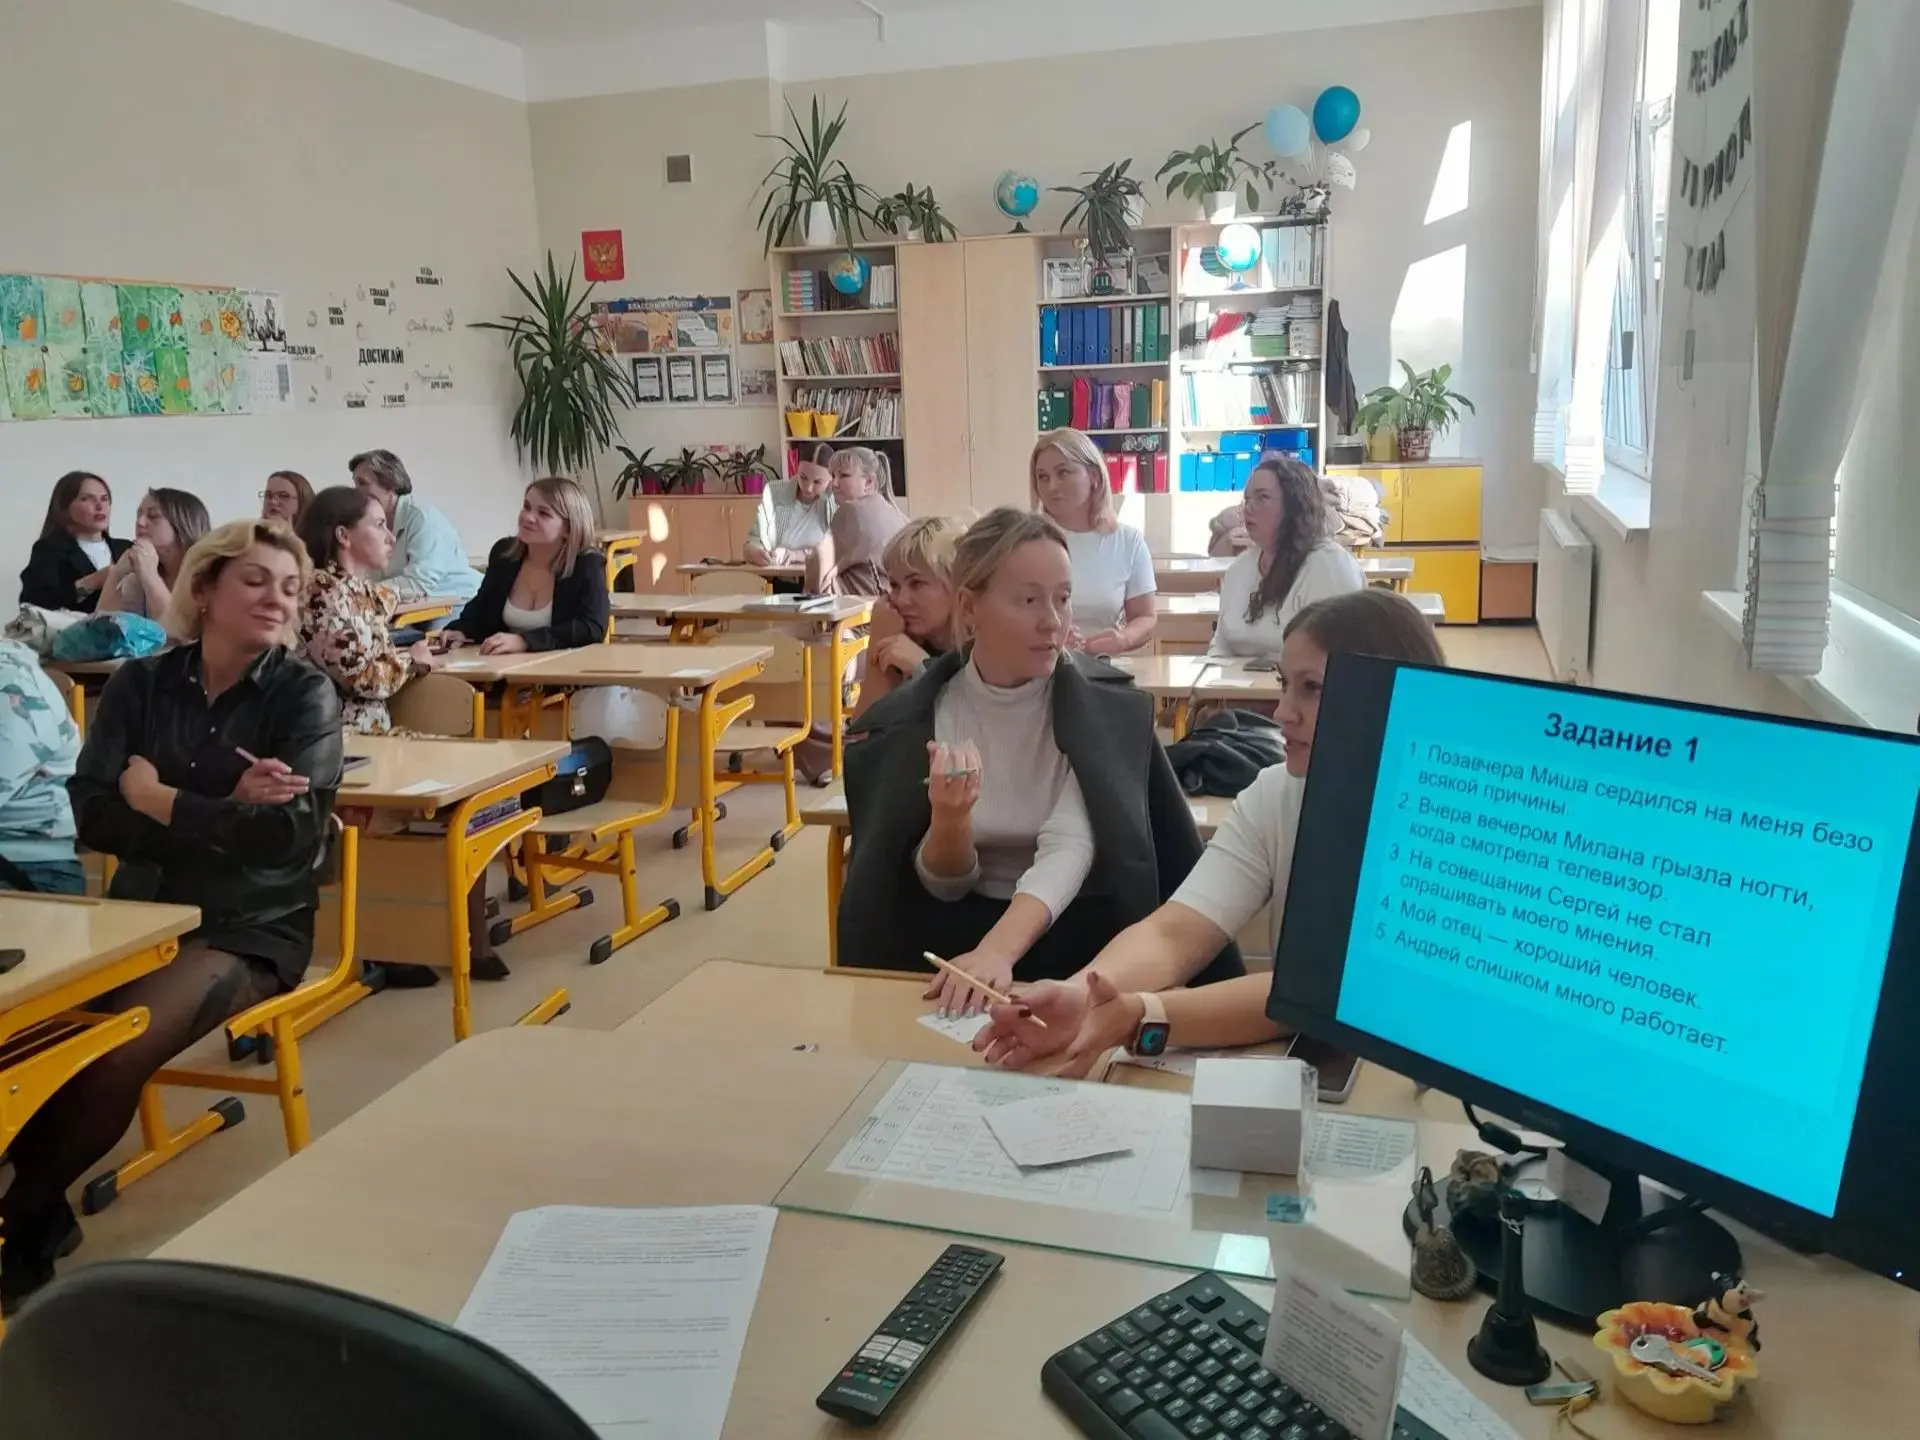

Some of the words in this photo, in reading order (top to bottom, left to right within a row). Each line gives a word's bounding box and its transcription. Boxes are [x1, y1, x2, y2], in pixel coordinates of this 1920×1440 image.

[359, 347, 404, 366] ДОСТИГАЙ!
[1418, 769, 1478, 795] всякой
[1543, 712, 1672, 759] Задание
[1685, 736, 1699, 763] 1
[1427, 744, 1524, 781] Позавчера
[1530, 765, 1589, 794] Миша
[1594, 780, 1698, 817] сердился
[1704, 803, 1733, 825] на
[1740, 811, 1804, 839] меня
[1812, 821, 1874, 854] безо
[1408, 822, 1456, 846] когда
[1460, 835, 1550, 871] смотрела
[1556, 858, 1668, 903] телевизор.
[1408, 848, 1433, 871] На
[1437, 860, 1542, 901] совещании
[1547, 886, 1621, 922] Сергей
[1625, 911, 1653, 932] не
[1658, 920, 1712, 948] стал
[1418, 796, 1472, 825] Вчера
[1477, 812, 1557, 847] вечером
[1563, 831, 1645, 868] Милана
[1651, 855, 1733, 889] грызла
[1740, 875, 1815, 912] ногти,
[1399, 873, 1507, 917] спрашивать
[1511, 906, 1570, 935] моего
[1574, 924, 1659, 963] мнения.
[1399, 899, 1437, 926] Мой
[1441, 915, 1483, 944] отец
[1513, 938, 1602, 977] хороший
[1607, 967, 1703, 1011] человек.
[1394, 929, 1461, 966] Андрей
[1465, 955, 1551, 995] слишком
[1554, 983, 1616, 1017] много
[1620, 1006, 1729, 1056] работает.
